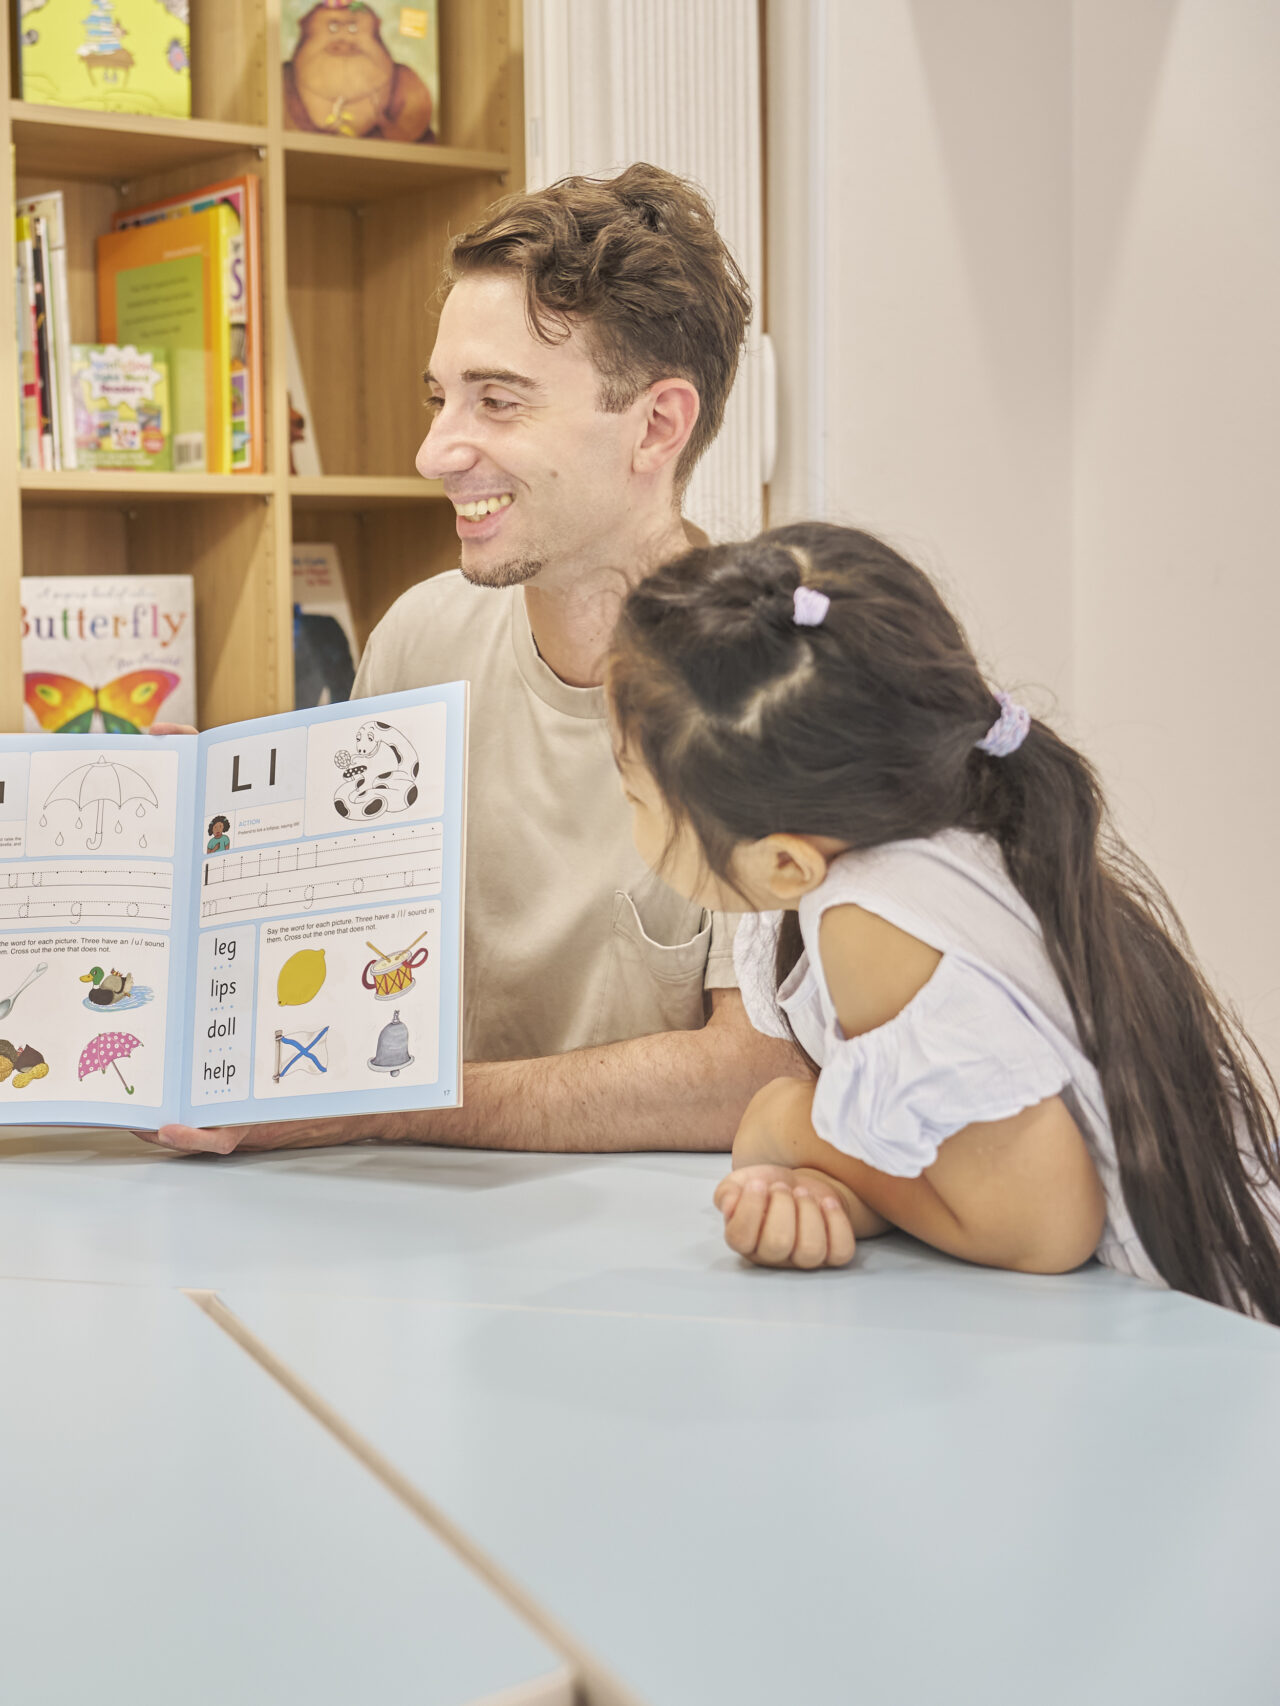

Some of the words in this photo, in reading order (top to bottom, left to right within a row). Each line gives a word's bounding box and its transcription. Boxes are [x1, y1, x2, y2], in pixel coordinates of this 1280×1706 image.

[231, 755, 252, 792] L
[408, 908, 427, 916] sound
[214, 938, 236, 960] leg
[210, 979, 236, 1003] lips
[207, 1017, 236, 1038] doll
[203, 1062, 236, 1084] help
